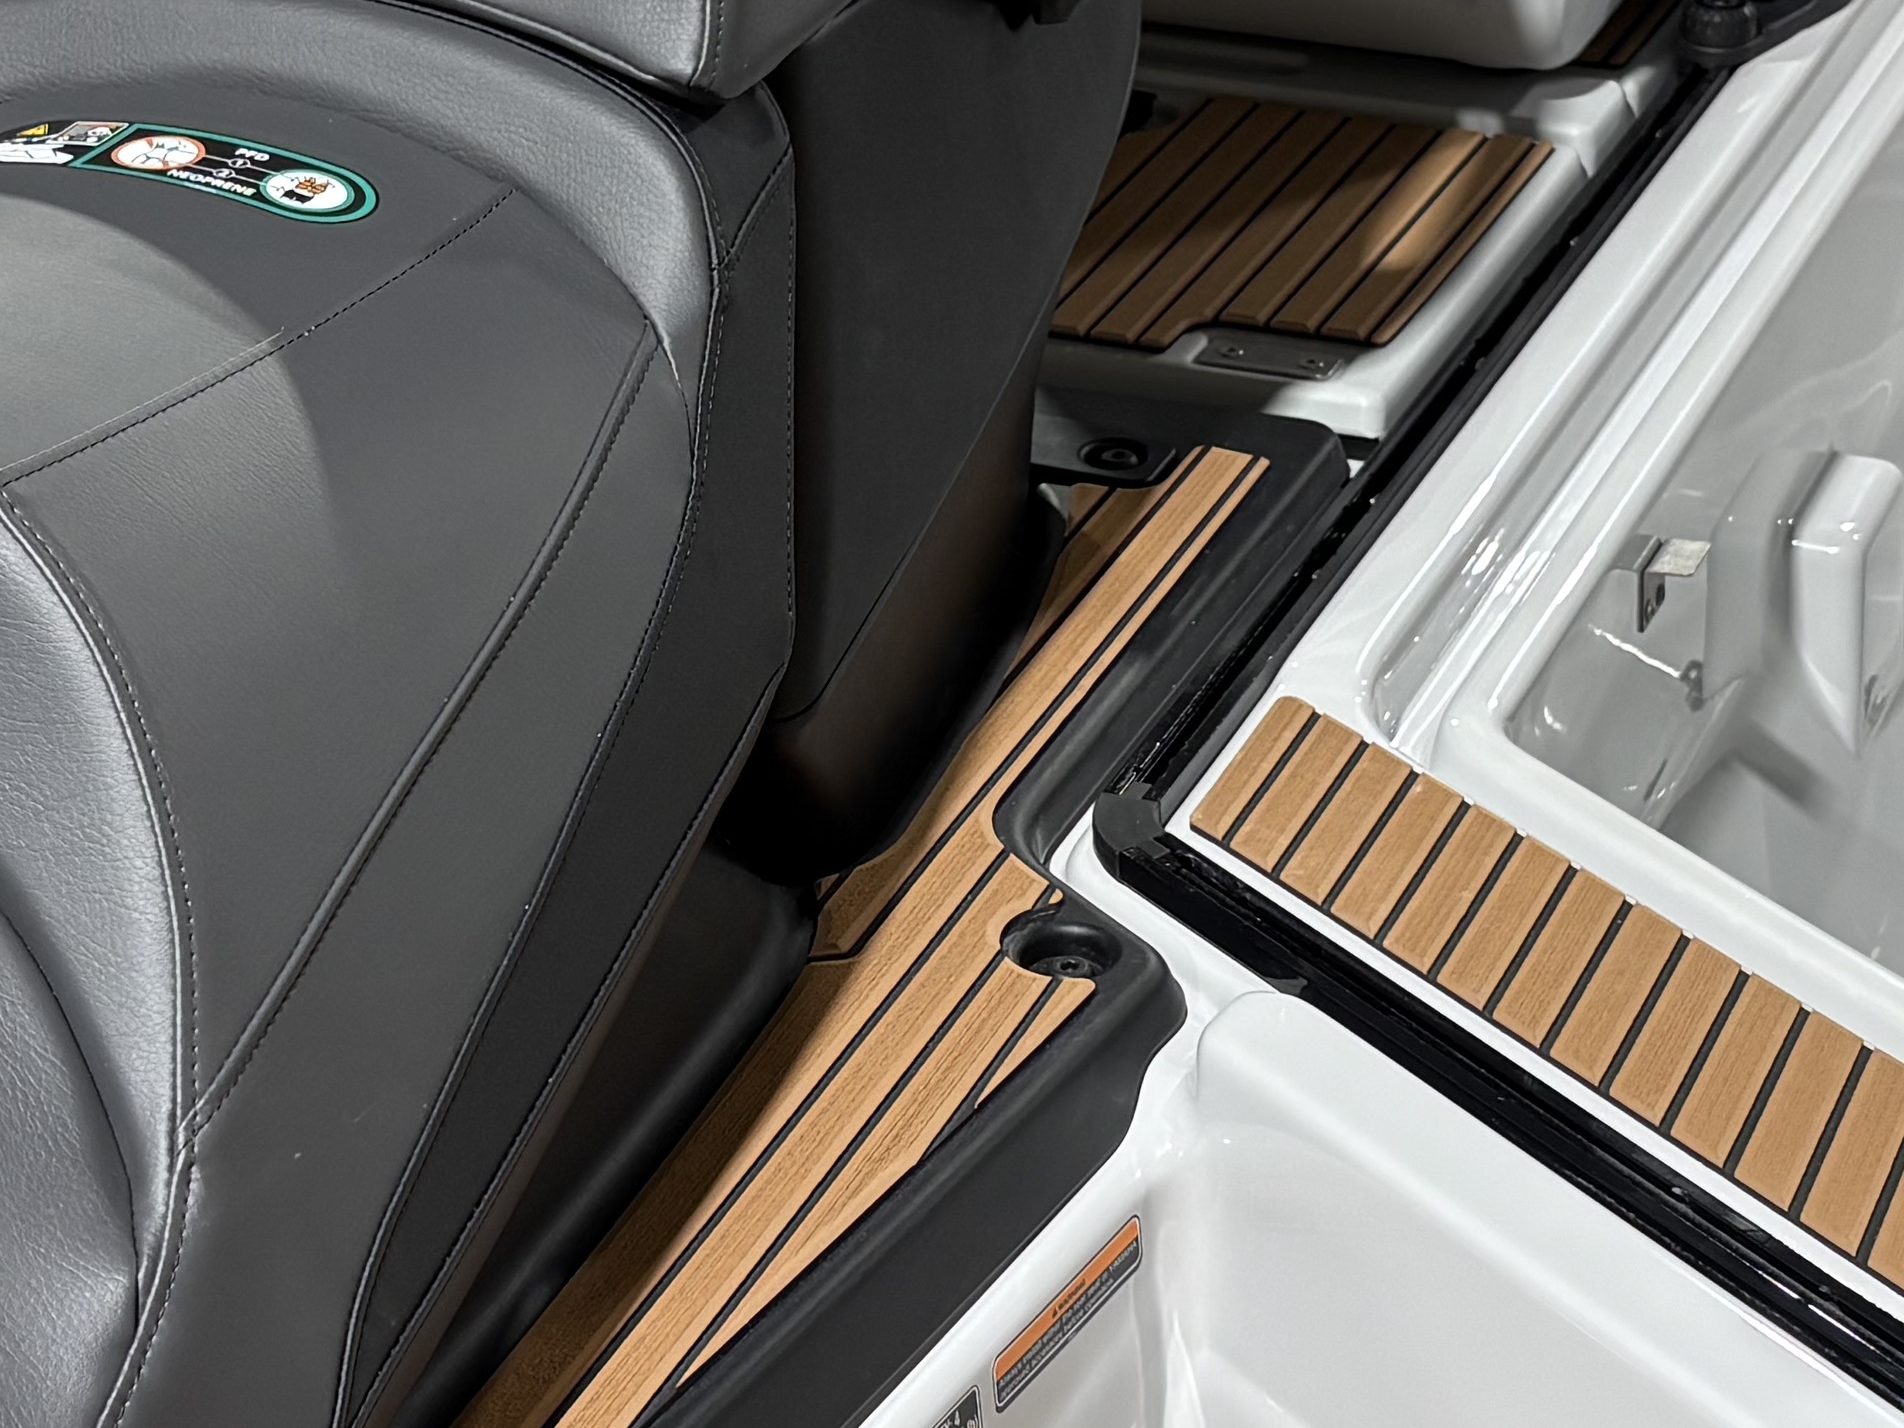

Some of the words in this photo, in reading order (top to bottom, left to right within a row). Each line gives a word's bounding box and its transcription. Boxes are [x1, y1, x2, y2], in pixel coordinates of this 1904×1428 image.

[234, 147, 270, 161] PFD
[166, 169, 257, 196] NEOPRENE
[954, 1410, 961, 1426] 4
